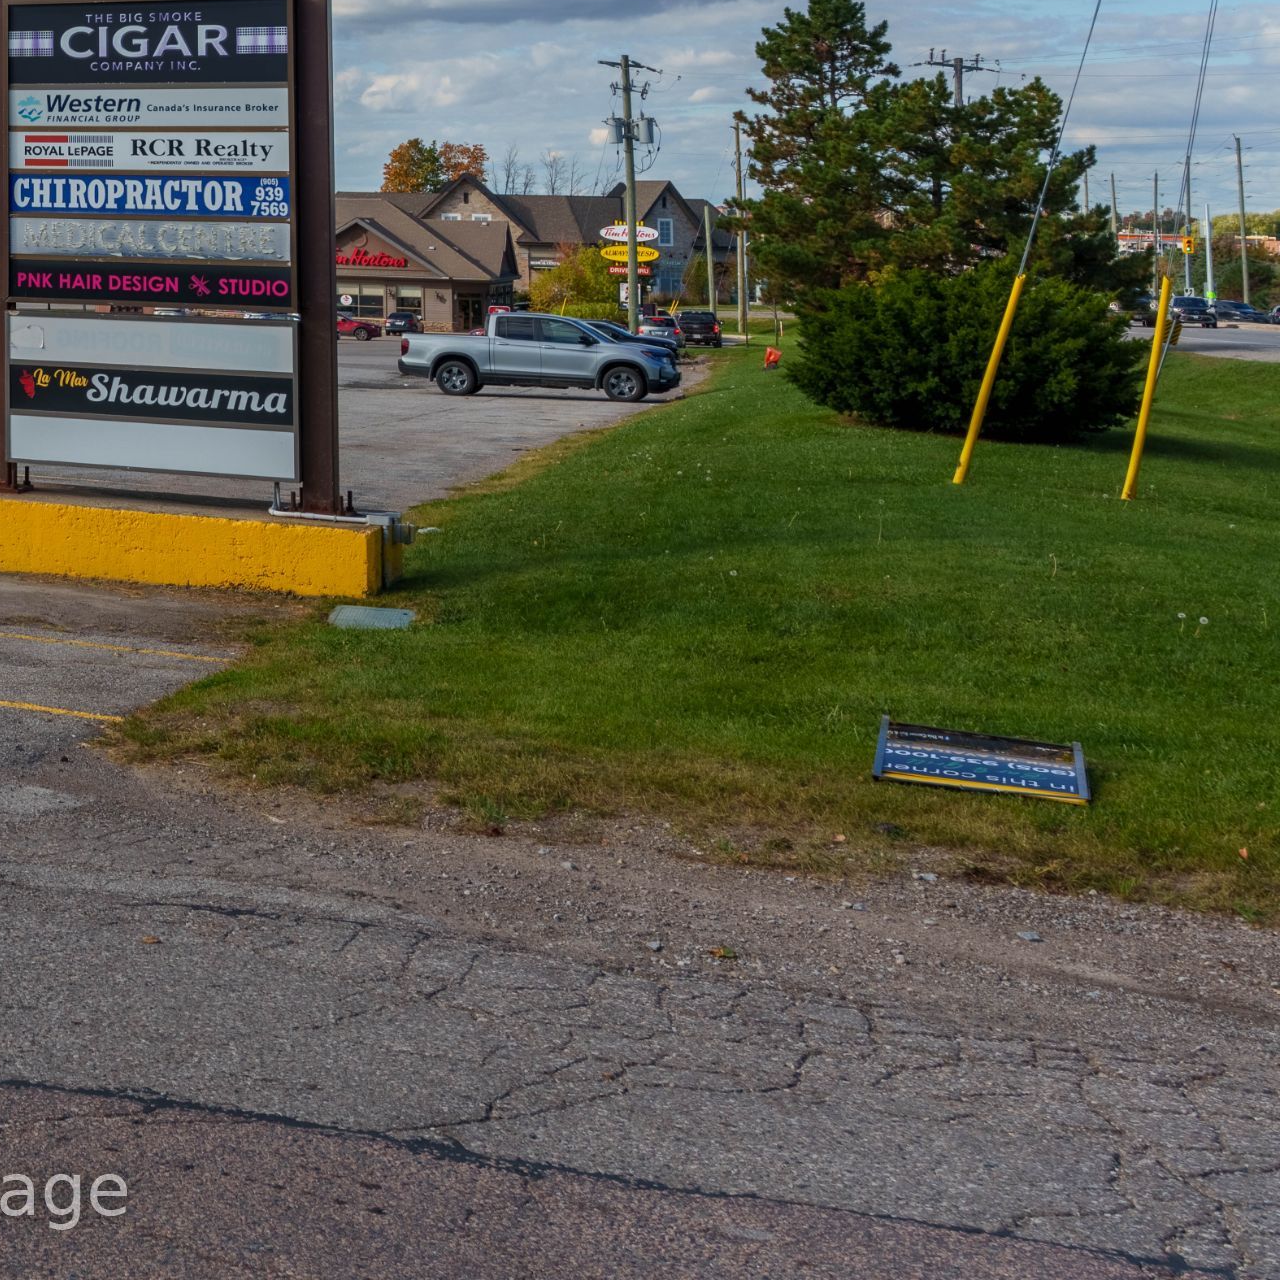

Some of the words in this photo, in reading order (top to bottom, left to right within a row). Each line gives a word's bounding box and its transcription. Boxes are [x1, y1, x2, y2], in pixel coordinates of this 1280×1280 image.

[85, 13, 113, 23] THE
[119, 12, 143, 23] BIG
[148, 11, 203, 22] SMOKE
[60, 24, 229, 59] CIGAR
[90, 61, 165, 71] COMPANY
[170, 60, 201, 71] INC.
[46, 94, 141, 113] Western
[146, 103, 190, 112] Canada's
[193, 103, 241, 112] Insurance
[245, 103, 279, 112] Broker
[46, 115, 100, 123] FINANCIAL
[105, 115, 141, 123] GROUP
[24, 145, 65, 156] ROYAL
[130, 138, 186, 157] RCR
[194, 138, 274, 162] Realty
[260, 177, 279, 187] (905)
[13, 178, 244, 212] CHIROPRACTOR
[255, 186, 284, 201] 939
[250, 200, 289, 216] 7569
[350, 247, 406, 268] Hortons
[16, 272, 53, 289] PNK
[58, 273, 103, 290] HAIR
[108, 275, 179, 293] DESIGN
[218, 278, 289, 297] STUDIO
[33, 367, 51, 387] La
[53, 369, 89, 388] Mar
[86, 373, 287, 414] Shawarma
[1007, 763, 1076, 777] (905)
[985, 774, 1041, 787] this
